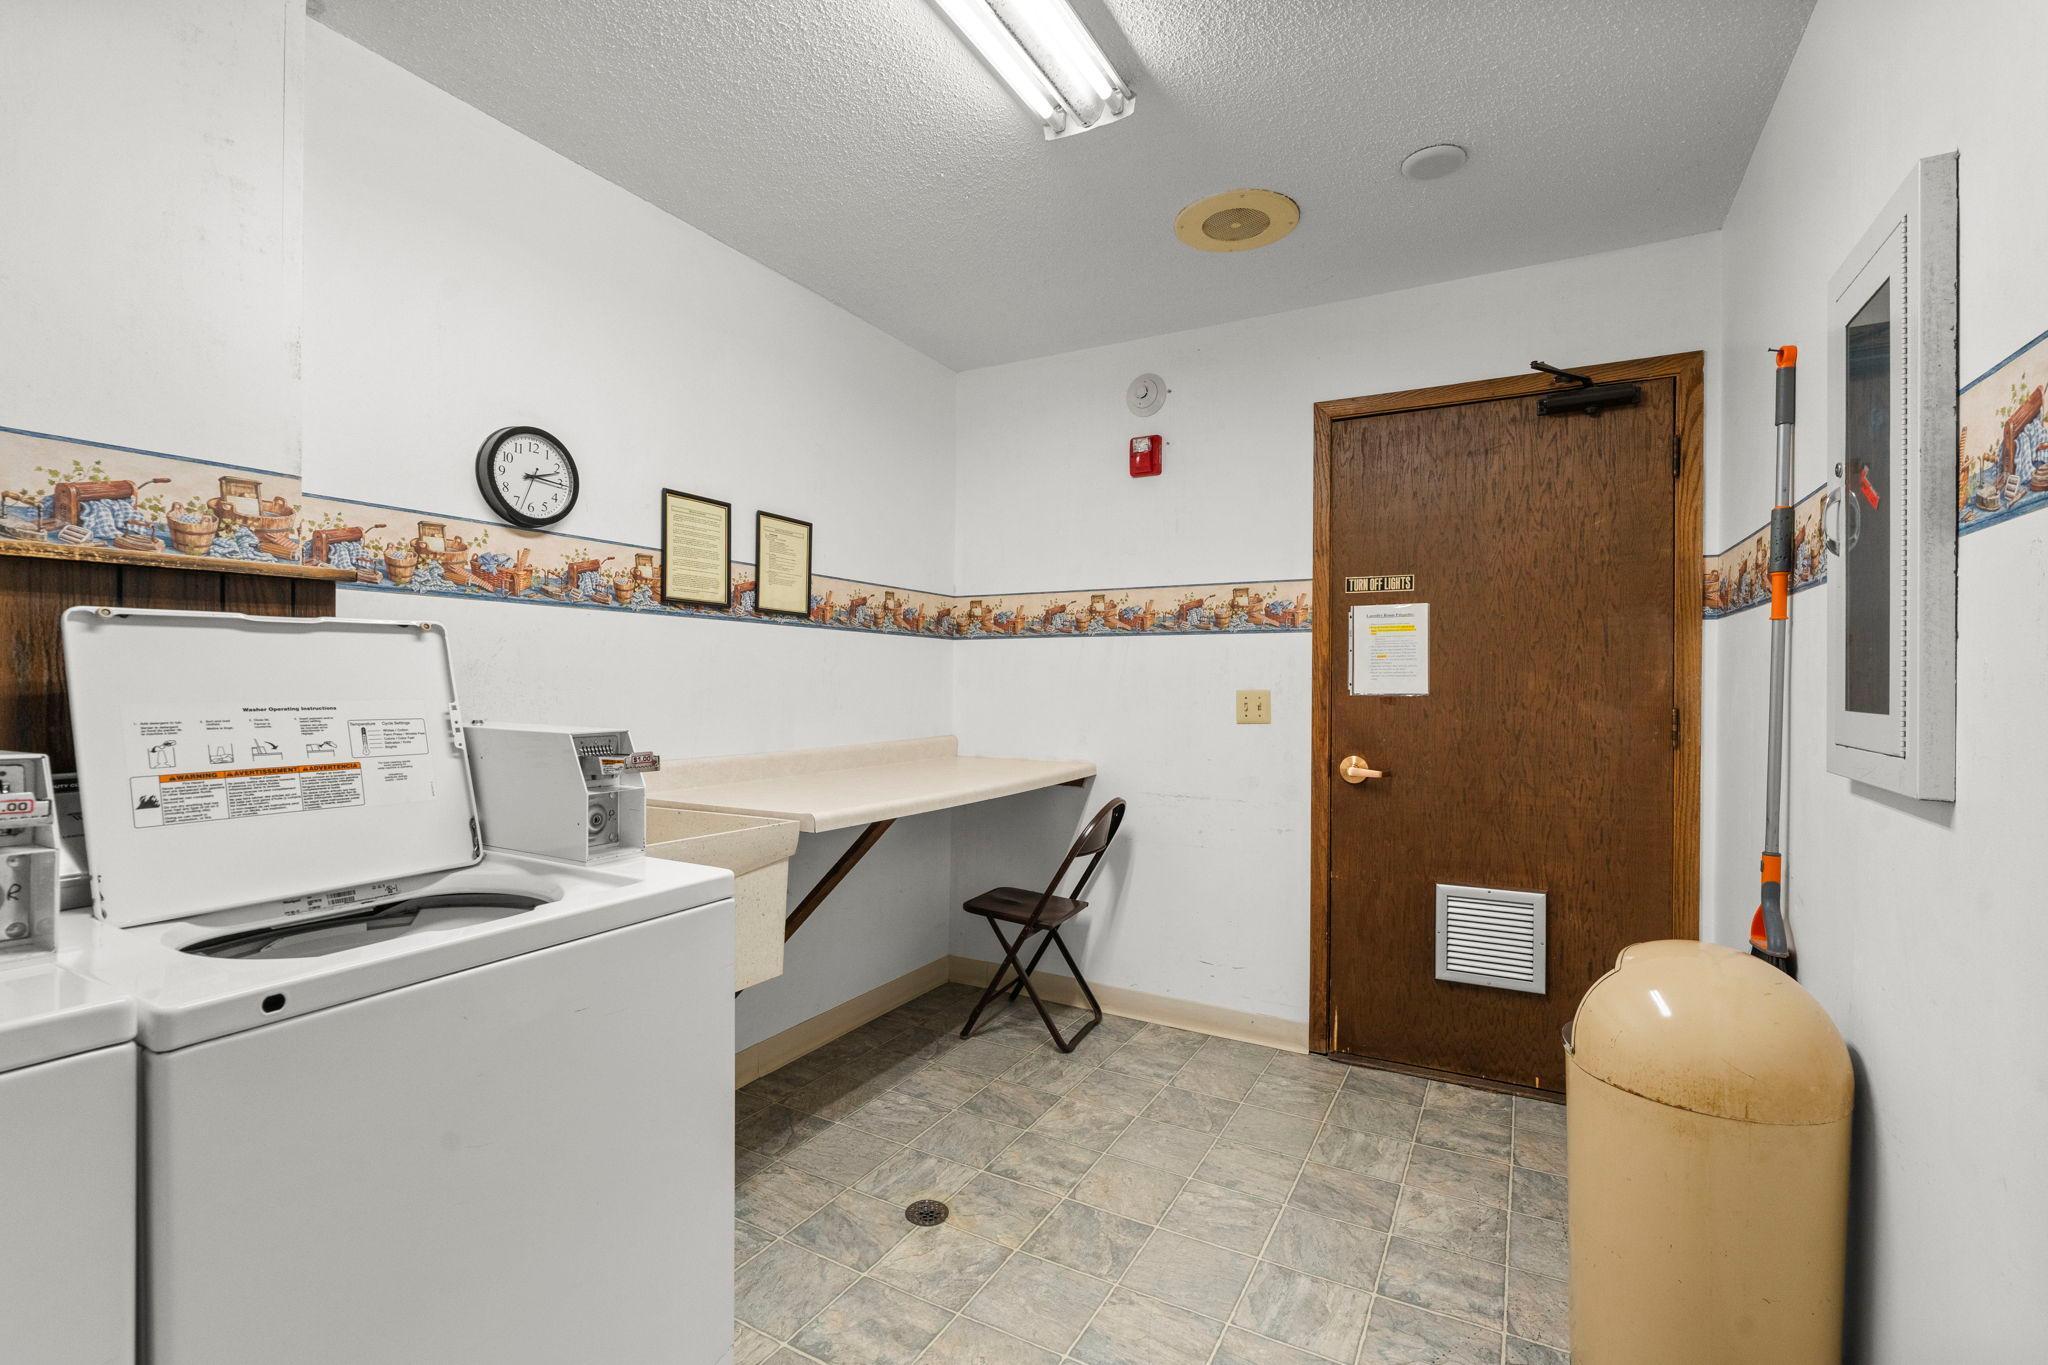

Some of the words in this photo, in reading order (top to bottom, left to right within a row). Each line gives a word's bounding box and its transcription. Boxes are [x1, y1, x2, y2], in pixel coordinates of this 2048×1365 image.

[514, 442, 523, 454] 11
[528, 441, 540, 455] 12
[502, 451, 514, 463] 10
[498, 464, 506, 475] 9
[553, 462, 560, 474] 2
[502, 481, 510, 493] 8
[513, 495, 520, 506] 7
[551, 492, 558, 503] 4
[527, 502, 535, 513] 6
[541, 501, 548, 512] 5
[1348, 578, 1369, 592] TURN
[1369, 577, 1383, 591] OFF
[1384, 576, 1411, 590] LIGHTS
[234, 767, 298, 777] AVERTISSEMENT
[309, 763, 358, 772] ADVERTENCIA
[176, 772, 218, 781] WARNING
